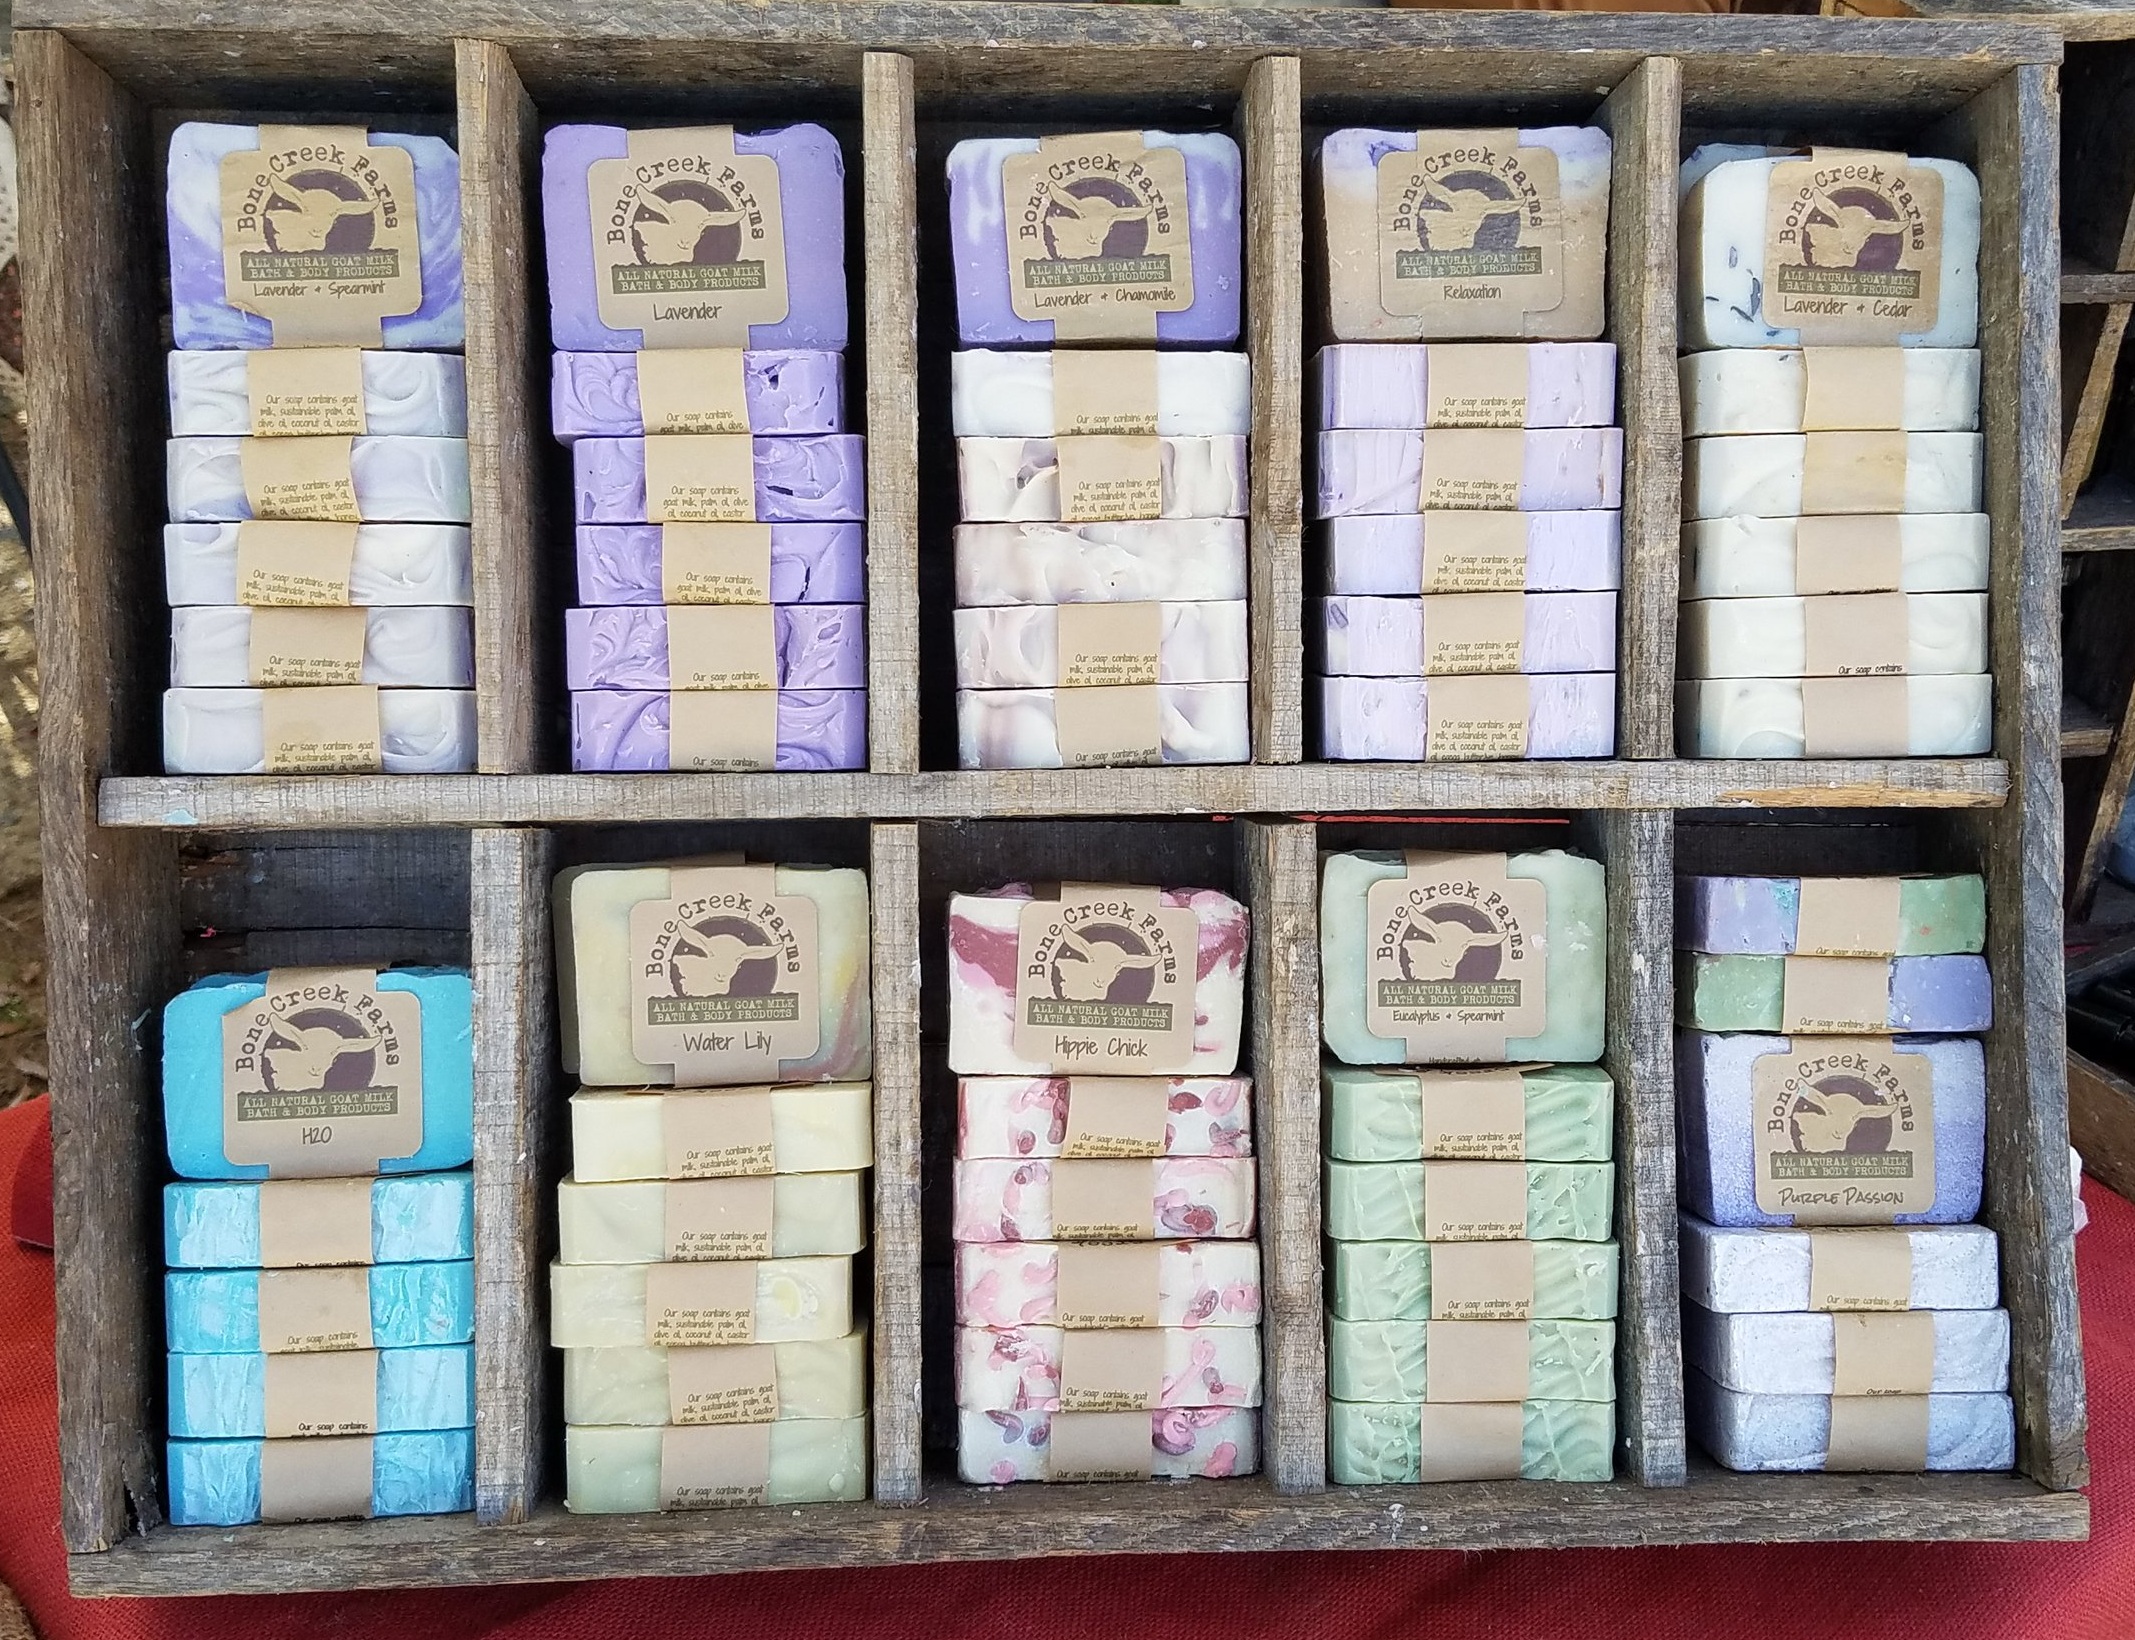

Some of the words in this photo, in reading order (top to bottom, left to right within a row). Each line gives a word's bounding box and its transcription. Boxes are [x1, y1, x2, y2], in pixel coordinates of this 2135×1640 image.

[238, 174, 270, 232] Bone
[269, 144, 345, 172] Creek
[350, 155, 398, 229] Farms
[1394, 174, 1424, 231] Bone
[1424, 147, 1496, 173] Creek
[1500, 156, 1542, 227] Farms
[607, 184, 637, 244] Bone
[636, 155, 711, 183] Creek
[716, 166, 764, 240] Farms
[1020, 181, 1049, 240] Bone
[1049, 154, 1121, 181] Creek
[1125, 162, 1170, 234] Farms
[1779, 187, 1813, 244] Bone
[1814, 165, 1885, 188] Creek
[1887, 178, 1924, 250] Farms
[247, 258, 271, 268] ALL
[275, 258, 328, 267] NATURAL
[332, 256, 361, 265] GOAT
[367, 255, 394, 265] MILK
[1401, 258, 1423, 266] ALL
[1426, 255, 1475, 265] NATURAL
[1480, 254, 1506, 263] GOAT
[1511, 253, 1538, 262] MILK
[250, 269, 281, 278] BATH
[286, 269, 294, 277] &
[300, 268, 329, 277] BODY
[336, 266, 393, 276] PRODUCTS
[617, 271, 640, 281] ALL
[644, 269, 695, 279] NATURAL
[700, 268, 728, 277] GOAT
[733, 267, 761, 276] MILK
[1029, 265, 1049, 275] ALL
[1055, 263, 1104, 273] NATURAL
[1109, 261, 1135, 271] GOAT
[1140, 260, 1167, 270] MILK
[1405, 267, 1431, 276] BATH
[1437, 267, 1444, 275] &
[1450, 266, 1477, 274] BODY
[1482, 264, 1535, 273] PRODUCTS
[621, 281, 650, 291] BATH
[657, 281, 663, 289] &
[670, 279, 698, 288] BODY
[705, 277, 759, 287] PRODUCTS
[1033, 276, 1061, 285] BATH
[1067, 275, 1073, 283] &
[1079, 273, 1107, 282] BODY
[1111, 271, 1165, 281] PRODUCTS
[1783, 272, 1804, 280] ALL
[1808, 273, 1855, 282] NATURAL
[1860, 274, 1887, 283] GOAT
[1890, 276, 1917, 286] MILK
[254, 283, 307, 296] Lavender
[328, 281, 385, 299] Spearmint
[1444, 284, 1501, 300] Relaxation
[1786, 282, 1813, 291] BATH
[1818, 283, 1824, 292] &
[1830, 284, 1858, 293] BODY
[1862, 285, 1914, 296] PRODUCTS
[1034, 291, 1092, 308] Lavender
[1116, 287, 1176, 301] Chamomile
[653, 302, 722, 321] Lavender
[1784, 296, 1848, 314] Lavender
[1873, 300, 1912, 317] Cedar
[266, 395, 280, 404] Our
[285, 396, 303, 406] soap
[308, 395, 337, 403] contains
[342, 395, 358, 406] goat
[671, 486, 685, 494] Our
[690, 488, 706, 497] soap
[710, 486, 739, 494] contains
[1839, 666, 1852, 674] Our
[1856, 667, 1871, 675] soap
[1875, 663, 1902, 672] contains
[1441, 720, 1453, 728] Our
[1458, 722, 1473, 731] soap
[1477, 720, 1504, 729] contains
[1508, 721, 1522, 731] goat
[1377, 906, 1408, 960] Bone
[1409, 881, 1480, 905] Creek
[1483, 892, 1523, 960] Farms
[646, 920, 678, 977] Bone
[678, 893, 752, 920] Creek
[757, 903, 800, 973] Farms
[1029, 923, 1062, 978] Bone
[1063, 902, 1135, 924] Creek
[1138, 913, 1176, 984] Farms
[1384, 986, 1403, 994] ALL
[1408, 985, 1456, 994] NATURAL
[1460, 985, 1486, 994] GOAT
[1491, 985, 1517, 994] MILK
[653, 1003, 675, 1012] ALL
[680, 1001, 730, 1011] NATURAL
[735, 1000, 762, 1009] GOAT
[767, 999, 794, 1008] MILK
[1386, 995, 1413, 1004] BATH
[1418, 996, 1425, 1004] &
[1430, 995, 1457, 1004] BODY
[1463, 995, 1514, 1004] PRODUCTS
[657, 1013, 685, 1022] BATH
[691, 1012, 698, 1021] &
[704, 1011, 732, 1020] BODY
[739, 1009, 792, 1019] PRODUCTS
[1033, 1004, 1054, 1012] ALL
[1059, 1005, 1107, 1015] NATURAL
[1111, 1007, 1137, 1016] GOAT
[1142, 1008, 1168, 1018] MILK
[1393, 1010, 1440, 1025] Eucalyptus
[1458, 1010, 1505, 1025] Spearmint
[1036, 1014, 1063, 1023] BATH
[1068, 1015, 1075, 1024] &
[1081, 1016, 1108, 1025] BODY
[1113, 1017, 1165, 1027] PRODUCTS
[236, 1012, 270, 1072] Bone
[270, 984, 349, 1012] Creek
[354, 995, 399, 1065] Farms
[683, 1032, 735, 1051] Water
[744, 1031, 771, 1055] Lily
[1055, 1035, 1098, 1060] Hippie
[1107, 1037, 1148, 1057] Chick
[243, 1098, 266, 1108] ALL
[272, 1096, 325, 1106] NATURAL
[330, 1094, 359, 1104] GOAT
[365, 1093, 393, 1102] MILK
[1768, 1078, 1798, 1133] Bone
[1798, 1054, 1868, 1078] Creek
[1873, 1063, 1914, 1132] Farms
[247, 1109, 276, 1118] BATH
[282, 1108, 290, 1116] &
[298, 1106, 327, 1115] BODY
[333, 1104, 391, 1114] PRODUCTS
[303, 1126, 332, 1145] H2O
[1457, 1135, 1473, 1145] soap
[1477, 1133, 1504, 1141] contains
[1508, 1132, 1522, 1143] goat
[1776, 1158, 1795, 1167] ALL
[1800, 1157, 1848, 1166] NATURAL
[1852, 1157, 1877, 1166] GOAT
[1882, 1156, 1908, 1166] MILK
[1779, 1167, 1804, 1176] BATH
[1811, 1167, 1817, 1176] &
[1823, 1167, 1849, 1176] BODY
[1855, 1167, 1906, 1175] PRODUCTS
[664, 1309, 677, 1317] Our
[682, 1310, 698, 1319] soap
[703, 1309, 731, 1317] contains
[735, 1309, 750, 1320] goat
[299, 1423, 312, 1431] Our
